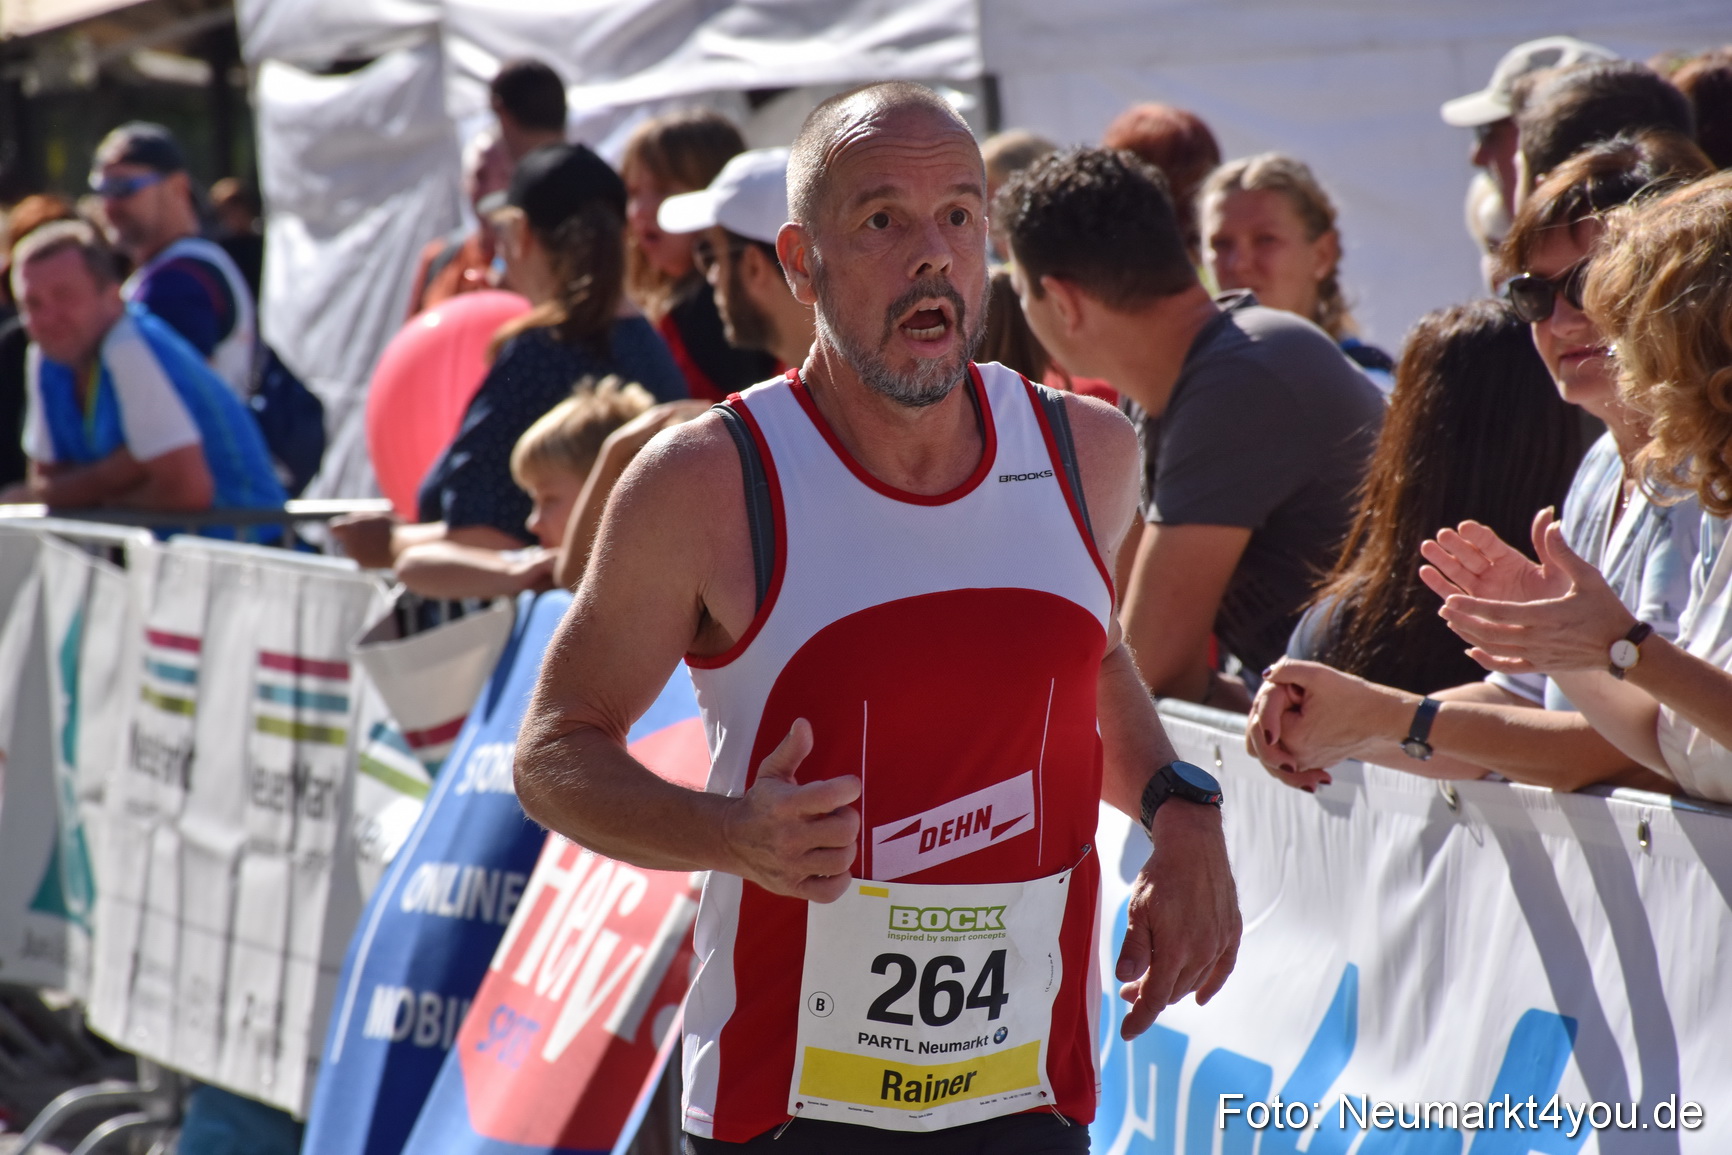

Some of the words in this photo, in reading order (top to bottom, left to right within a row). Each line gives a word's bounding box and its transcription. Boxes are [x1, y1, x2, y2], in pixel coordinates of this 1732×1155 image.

[999, 469, 1053, 483] BROOKS
[455, 742, 515, 796] STOR
[918, 804, 993, 855] DEHN
[401, 862, 529, 924] ONLINE
[888, 905, 1007, 932] BOCK
[490, 832, 707, 1063] Hervi
[887, 931, 924, 942] inspired
[927, 933, 938, 944] by
[940, 934, 966, 942] smart
[967, 932, 1006, 940] concepts
[867, 949, 1009, 1027] 264
[362, 985, 470, 1050] MOBI
[857, 1032, 914, 1053] PARTL
[918, 1035, 989, 1055] Neumarkt
[880, 1069, 978, 1103] Rainer
